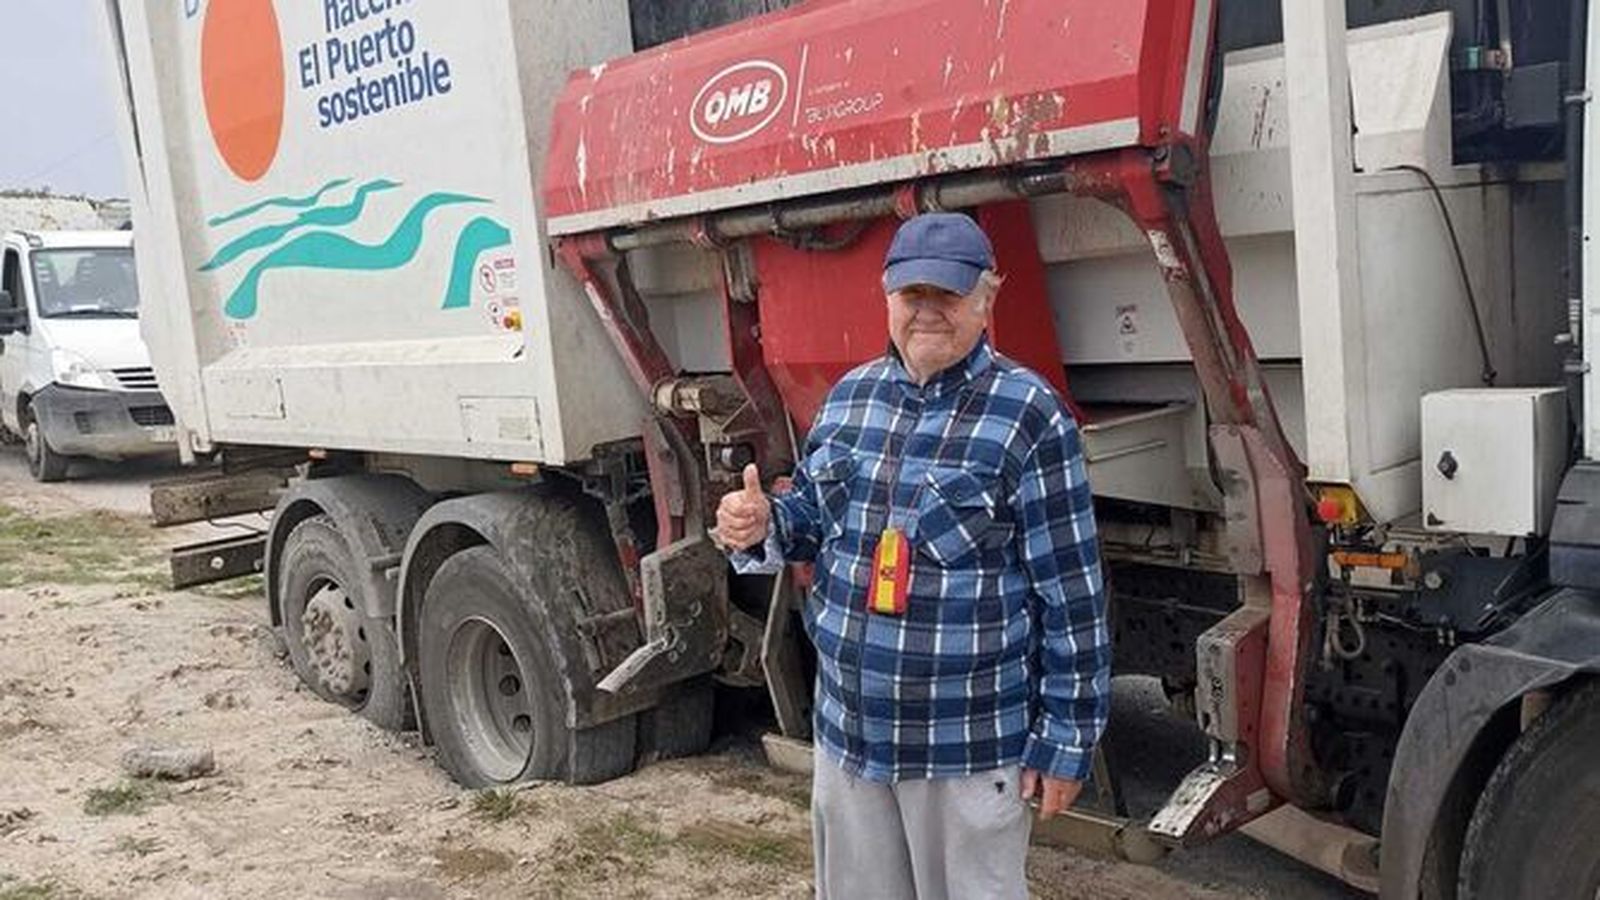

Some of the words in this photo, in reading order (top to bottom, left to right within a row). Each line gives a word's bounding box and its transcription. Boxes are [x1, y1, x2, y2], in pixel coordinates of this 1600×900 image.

[323, 0, 410, 33] hac
[299, 42, 321, 88] El
[326, 18, 415, 79] Puerto
[318, 52, 452, 128] sostenible
[704, 79, 772, 124] OMB
